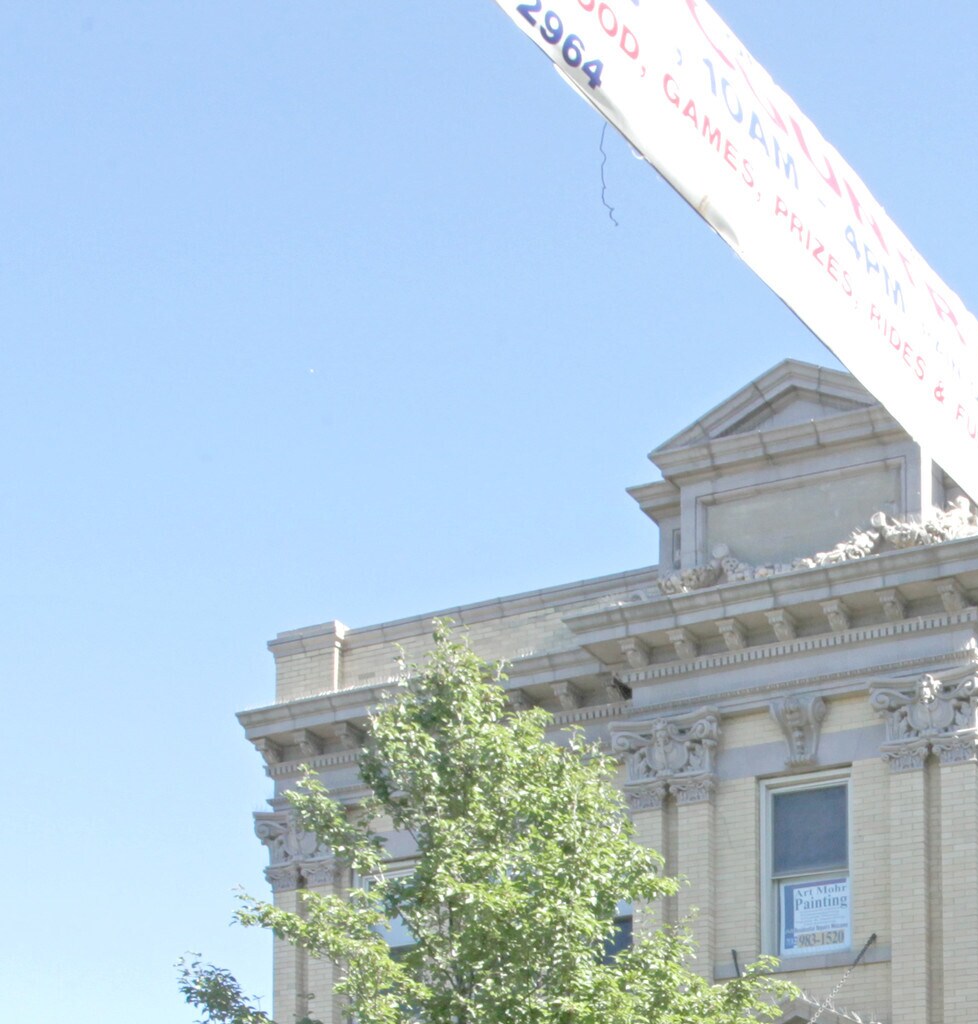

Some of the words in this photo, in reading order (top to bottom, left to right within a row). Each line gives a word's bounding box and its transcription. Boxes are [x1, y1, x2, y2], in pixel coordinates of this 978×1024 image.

[702, 57, 800, 191] 10AM
[662, 72, 762, 203] GAMES,
[868, 302, 925, 381] RIDES
[795, 895, 848, 911] Painting
[796, 889, 813, 898] Art
[816, 885, 847, 895] Mohr
